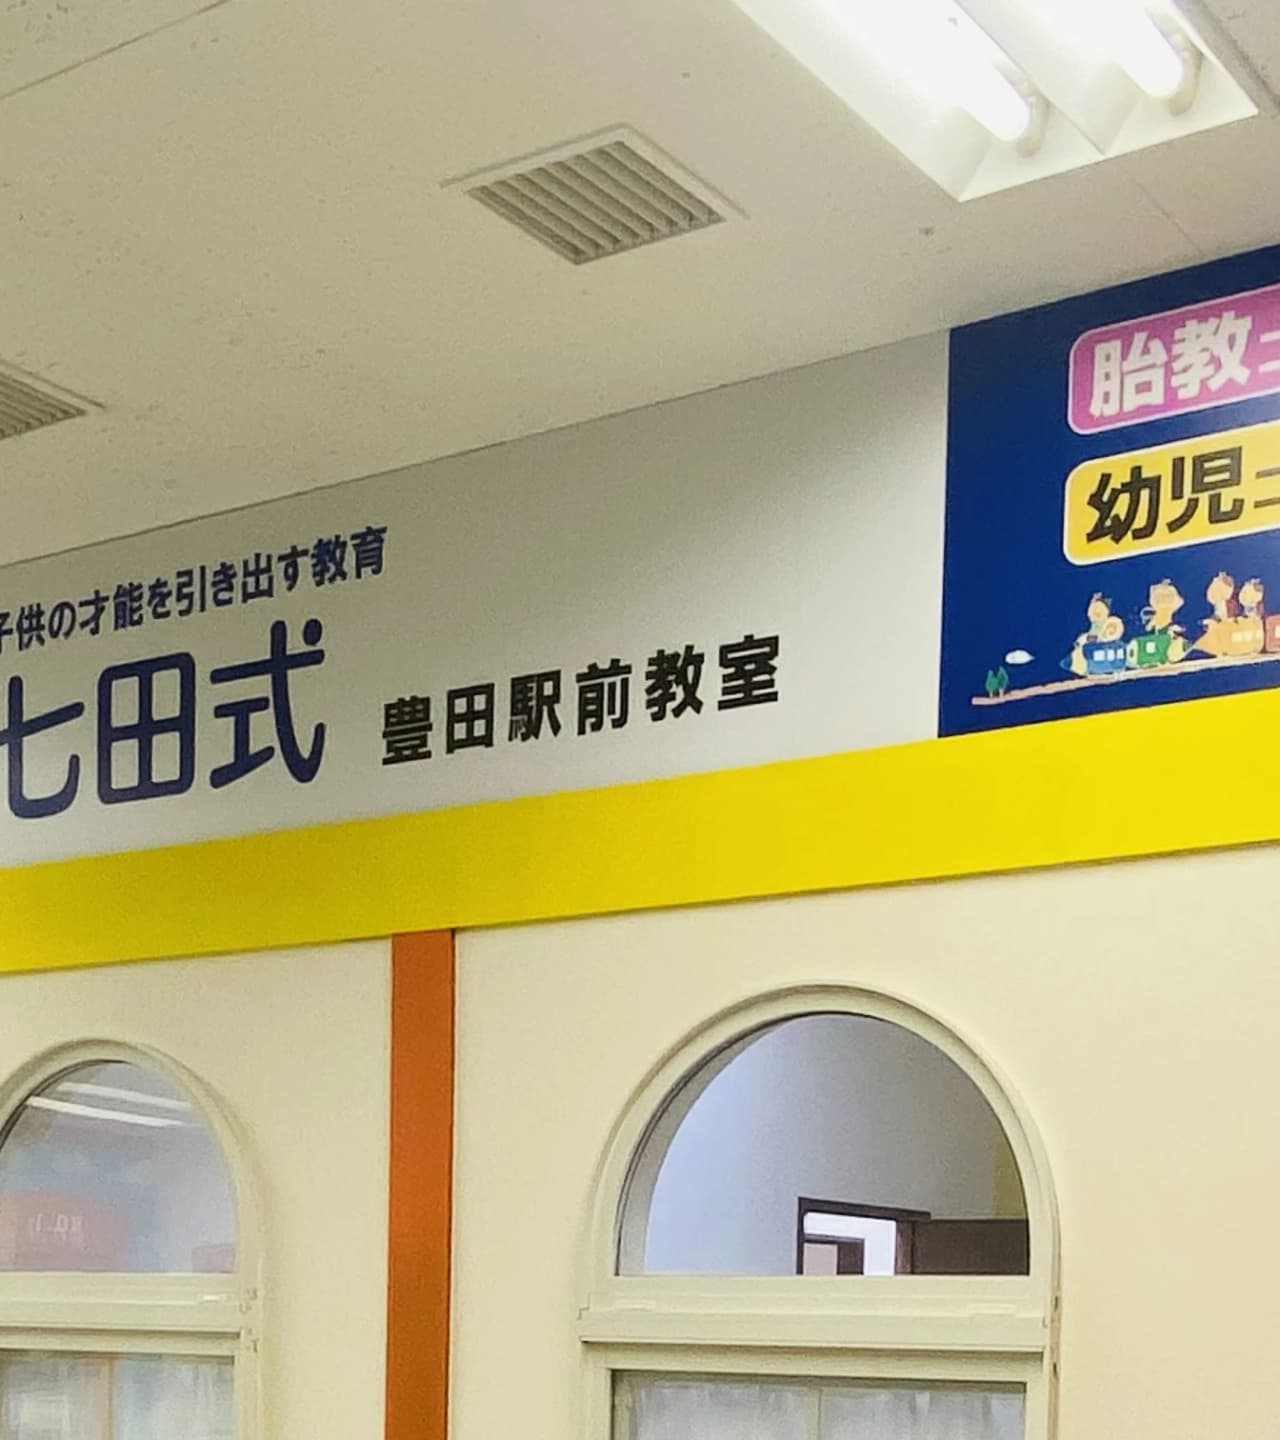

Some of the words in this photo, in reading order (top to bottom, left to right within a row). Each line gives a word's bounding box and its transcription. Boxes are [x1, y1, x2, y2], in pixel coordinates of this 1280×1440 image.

[381, 634, 780, 766] 豊田駅前教室
